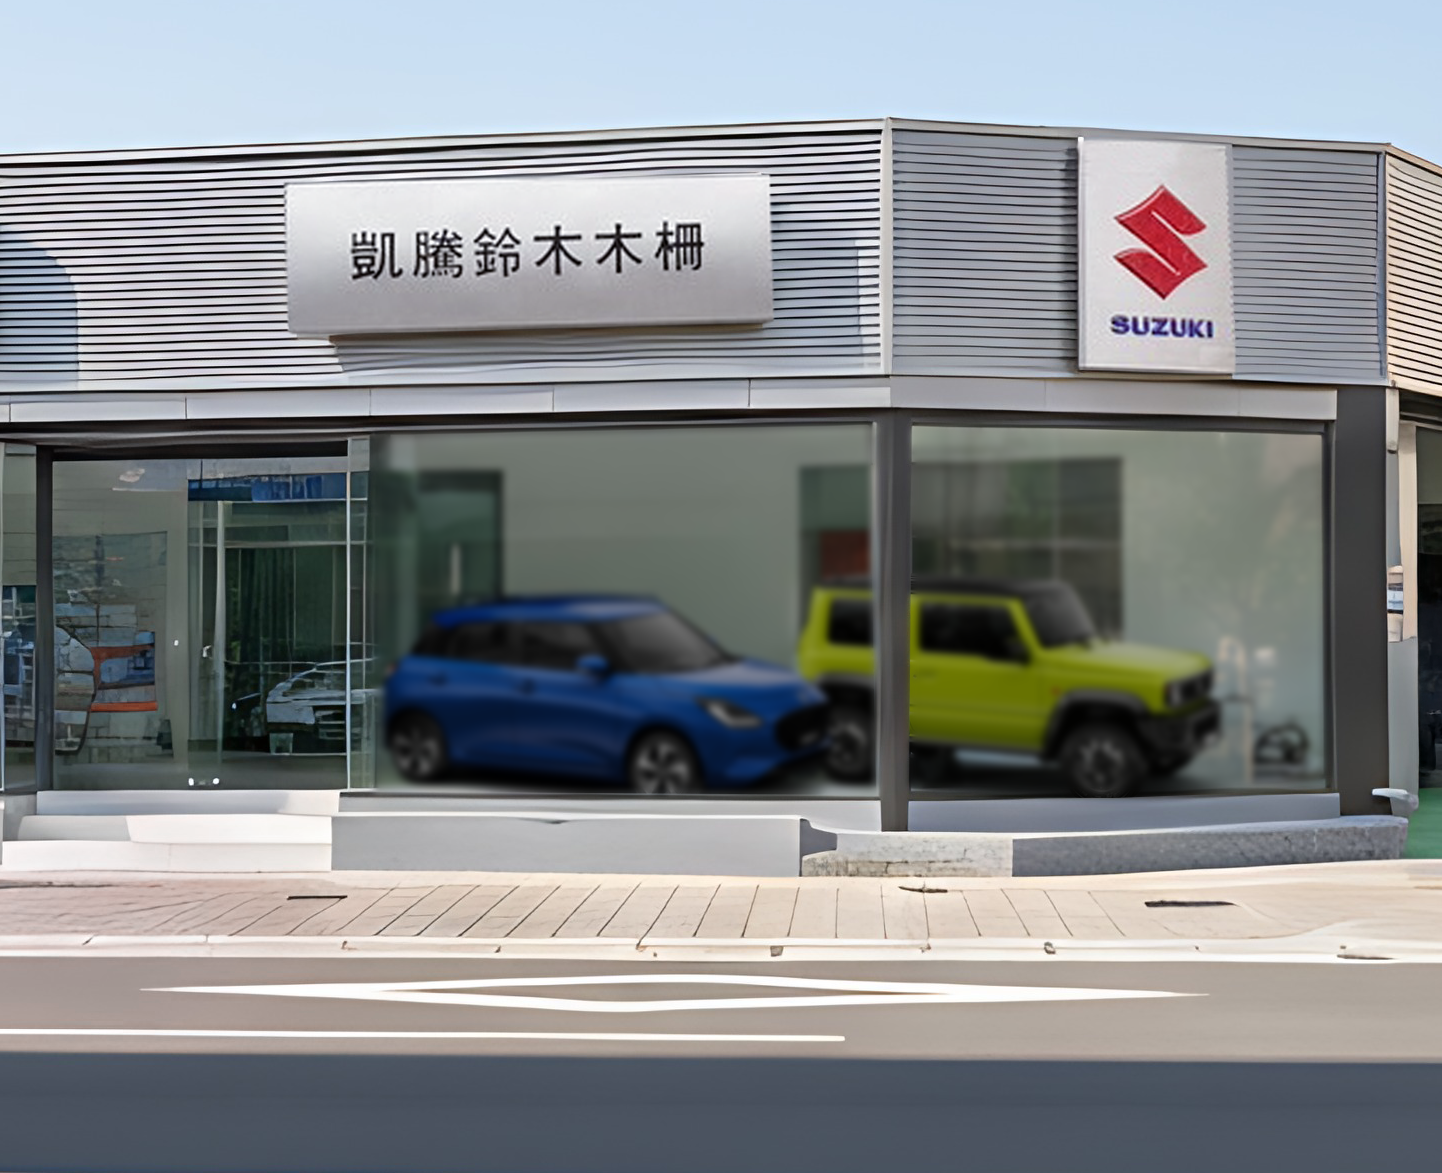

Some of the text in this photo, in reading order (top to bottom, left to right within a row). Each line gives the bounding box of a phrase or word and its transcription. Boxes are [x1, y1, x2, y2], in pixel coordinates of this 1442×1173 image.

[350, 221, 705, 280] 凱騰鈴木木柵
[1110, 314, 1214, 338] SUZUKI
